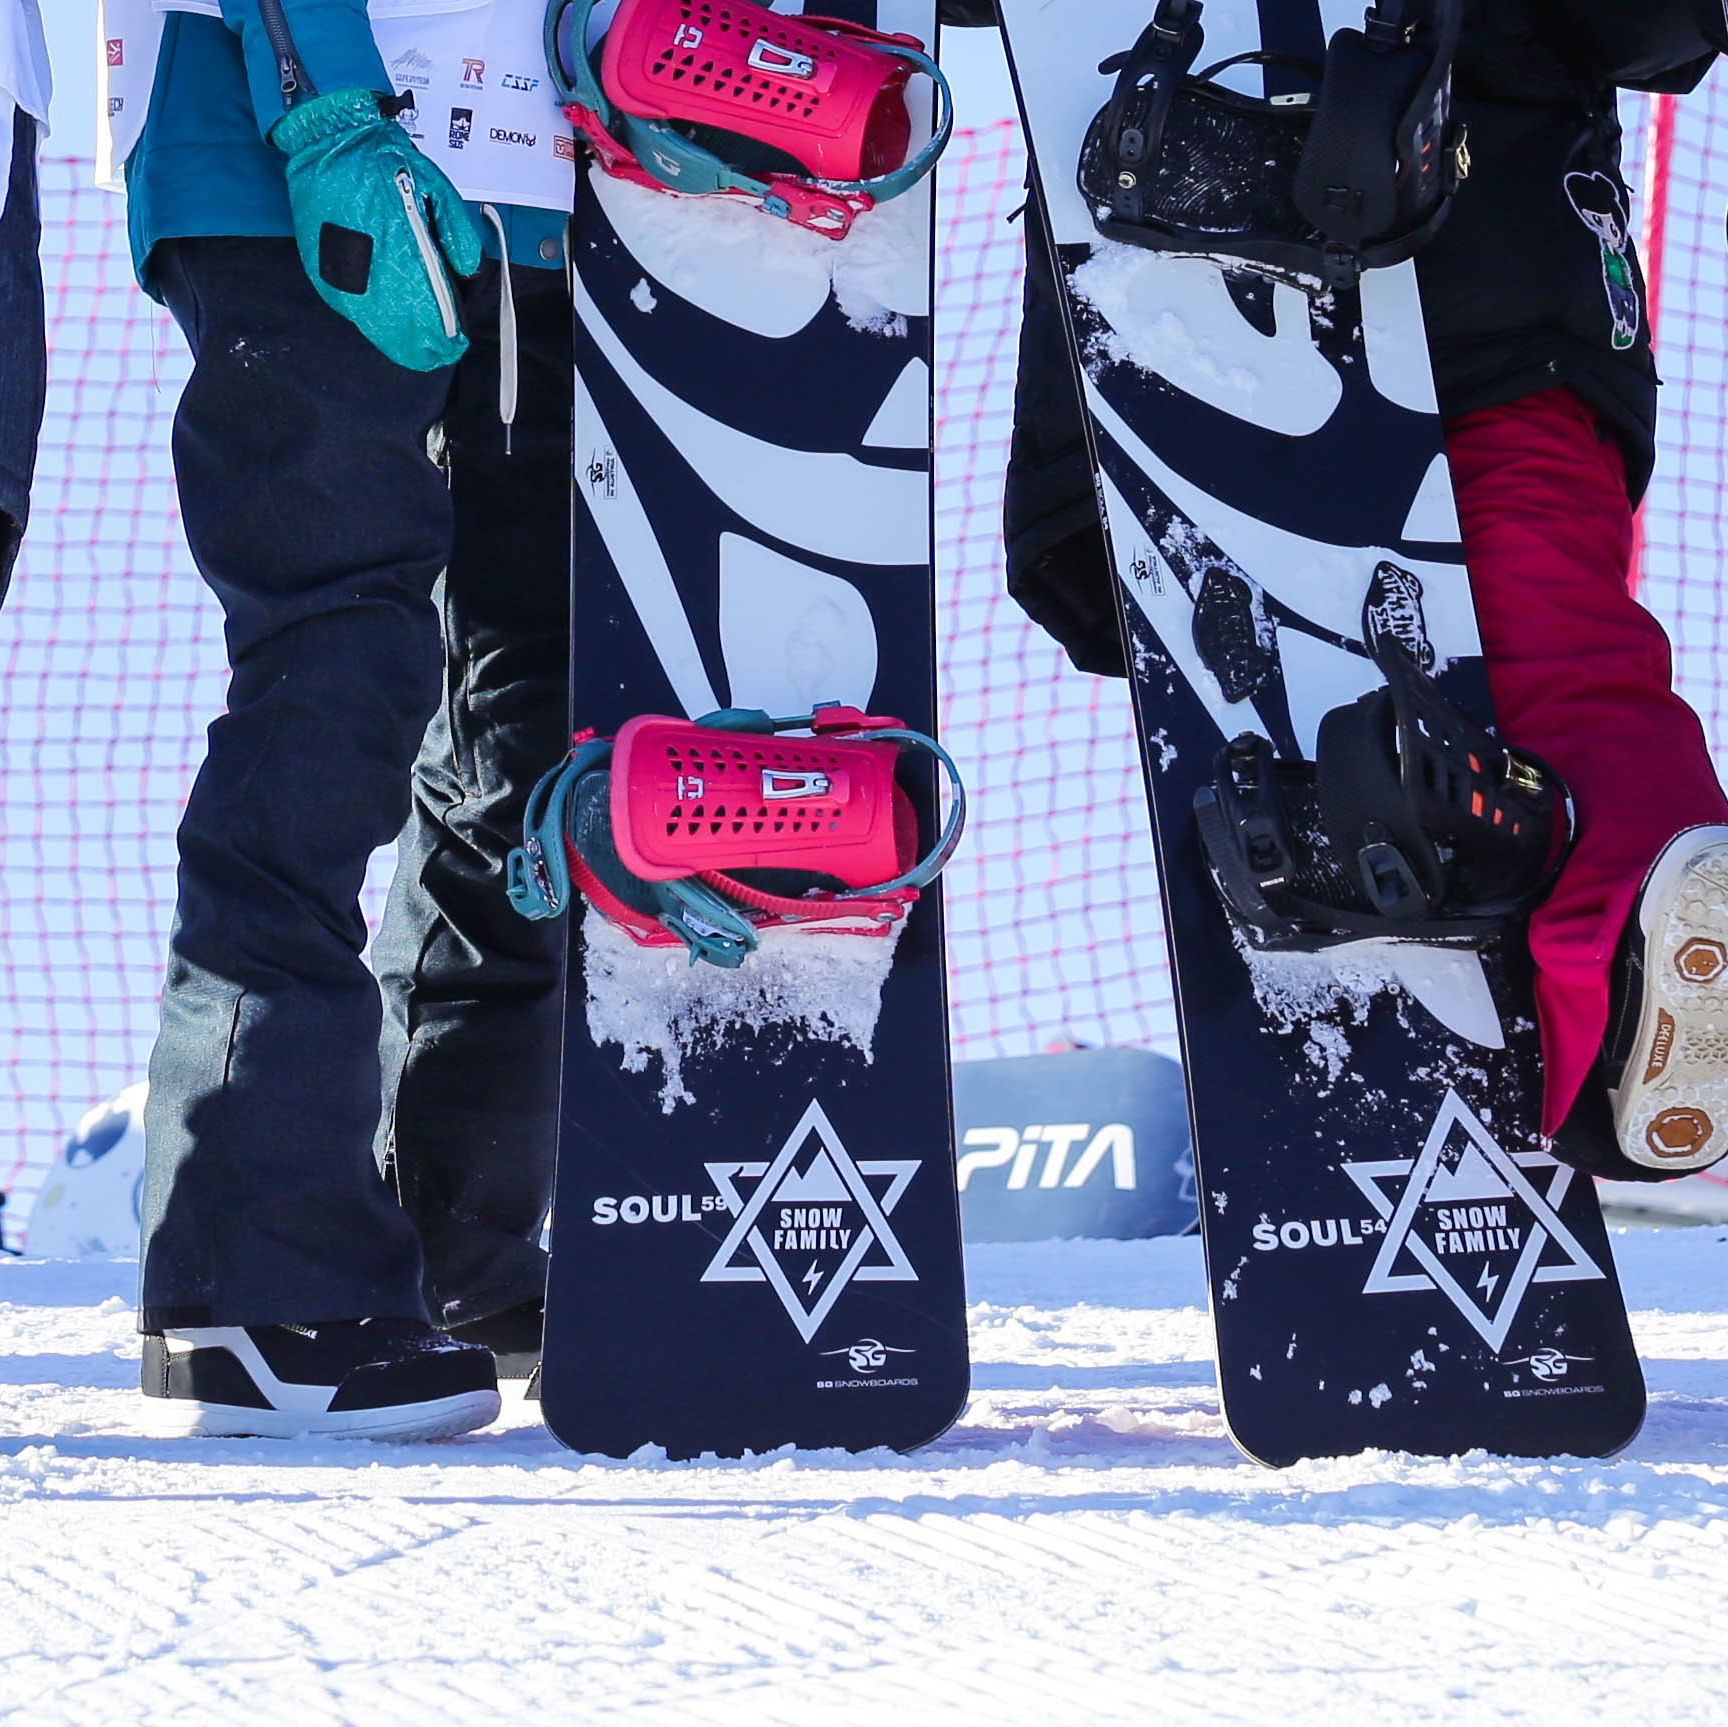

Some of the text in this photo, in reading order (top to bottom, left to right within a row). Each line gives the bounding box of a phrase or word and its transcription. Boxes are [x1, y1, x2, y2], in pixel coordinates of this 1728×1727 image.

[1652, 1023, 1672, 1068] DEELUXE
[780, 1207, 843, 1229] SNOW
[1437, 1205, 1507, 1230] SNOW
[773, 1229, 852, 1250] FAMILY
[1434, 1227, 1521, 1255] FAMILY
[834, 1377, 919, 1389] SNOWBOARDS
[1520, 1384, 1605, 1398] SNOWBOARDS
